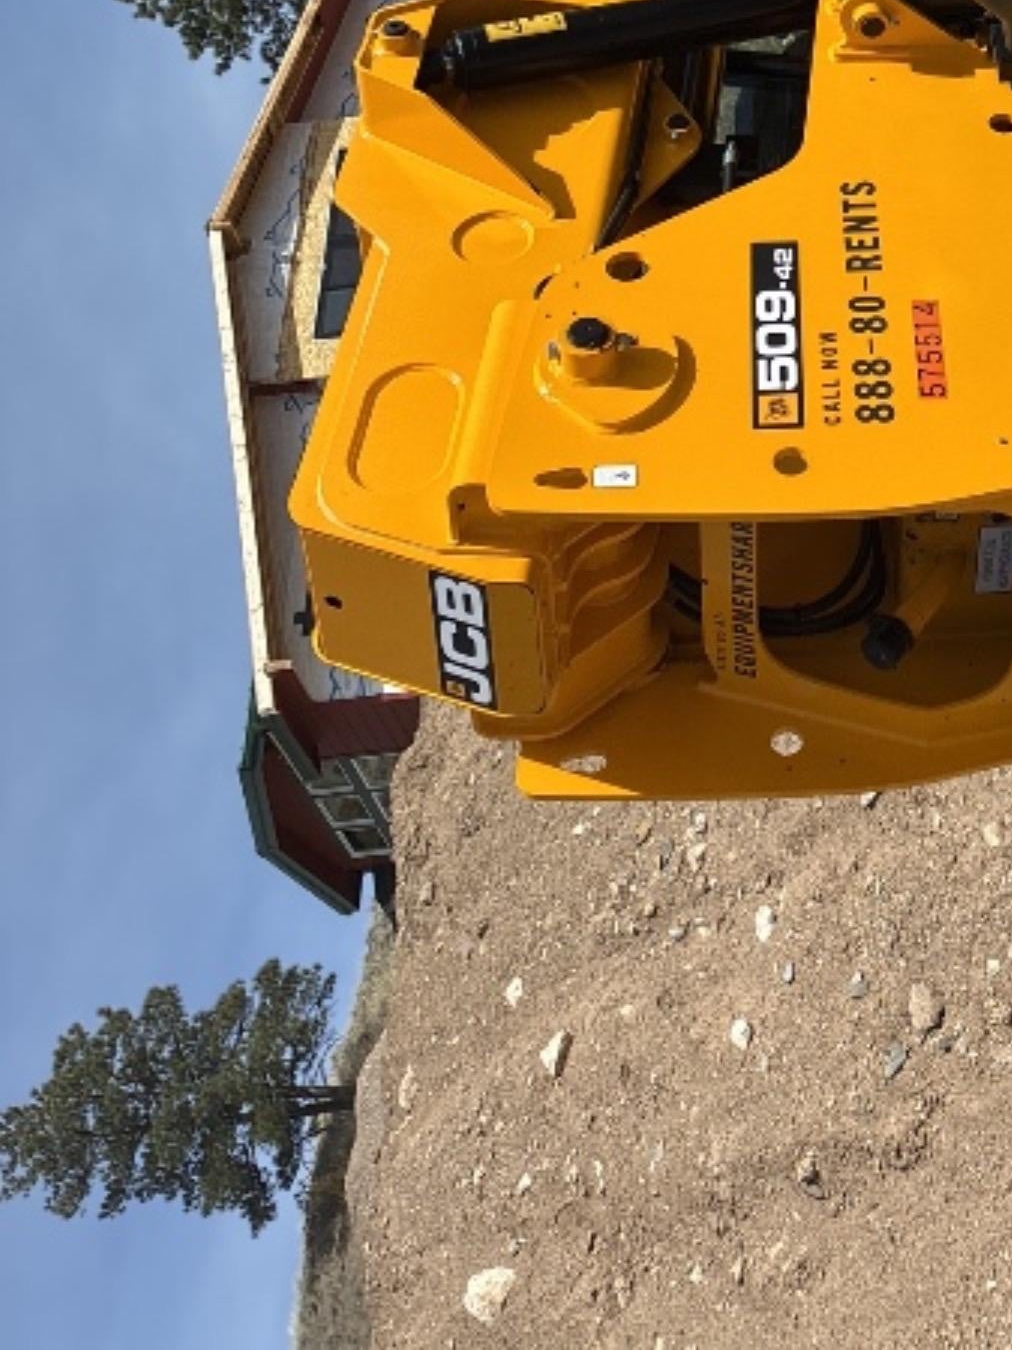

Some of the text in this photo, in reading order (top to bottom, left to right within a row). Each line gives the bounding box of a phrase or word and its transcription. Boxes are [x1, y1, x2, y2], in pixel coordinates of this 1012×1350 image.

[839, 179, 896, 425] 888-80-RENTS
[911, 300, 949, 400] 575514
[818, 330, 842, 427] CALL NOW
[434, 574, 493, 705] JCB
